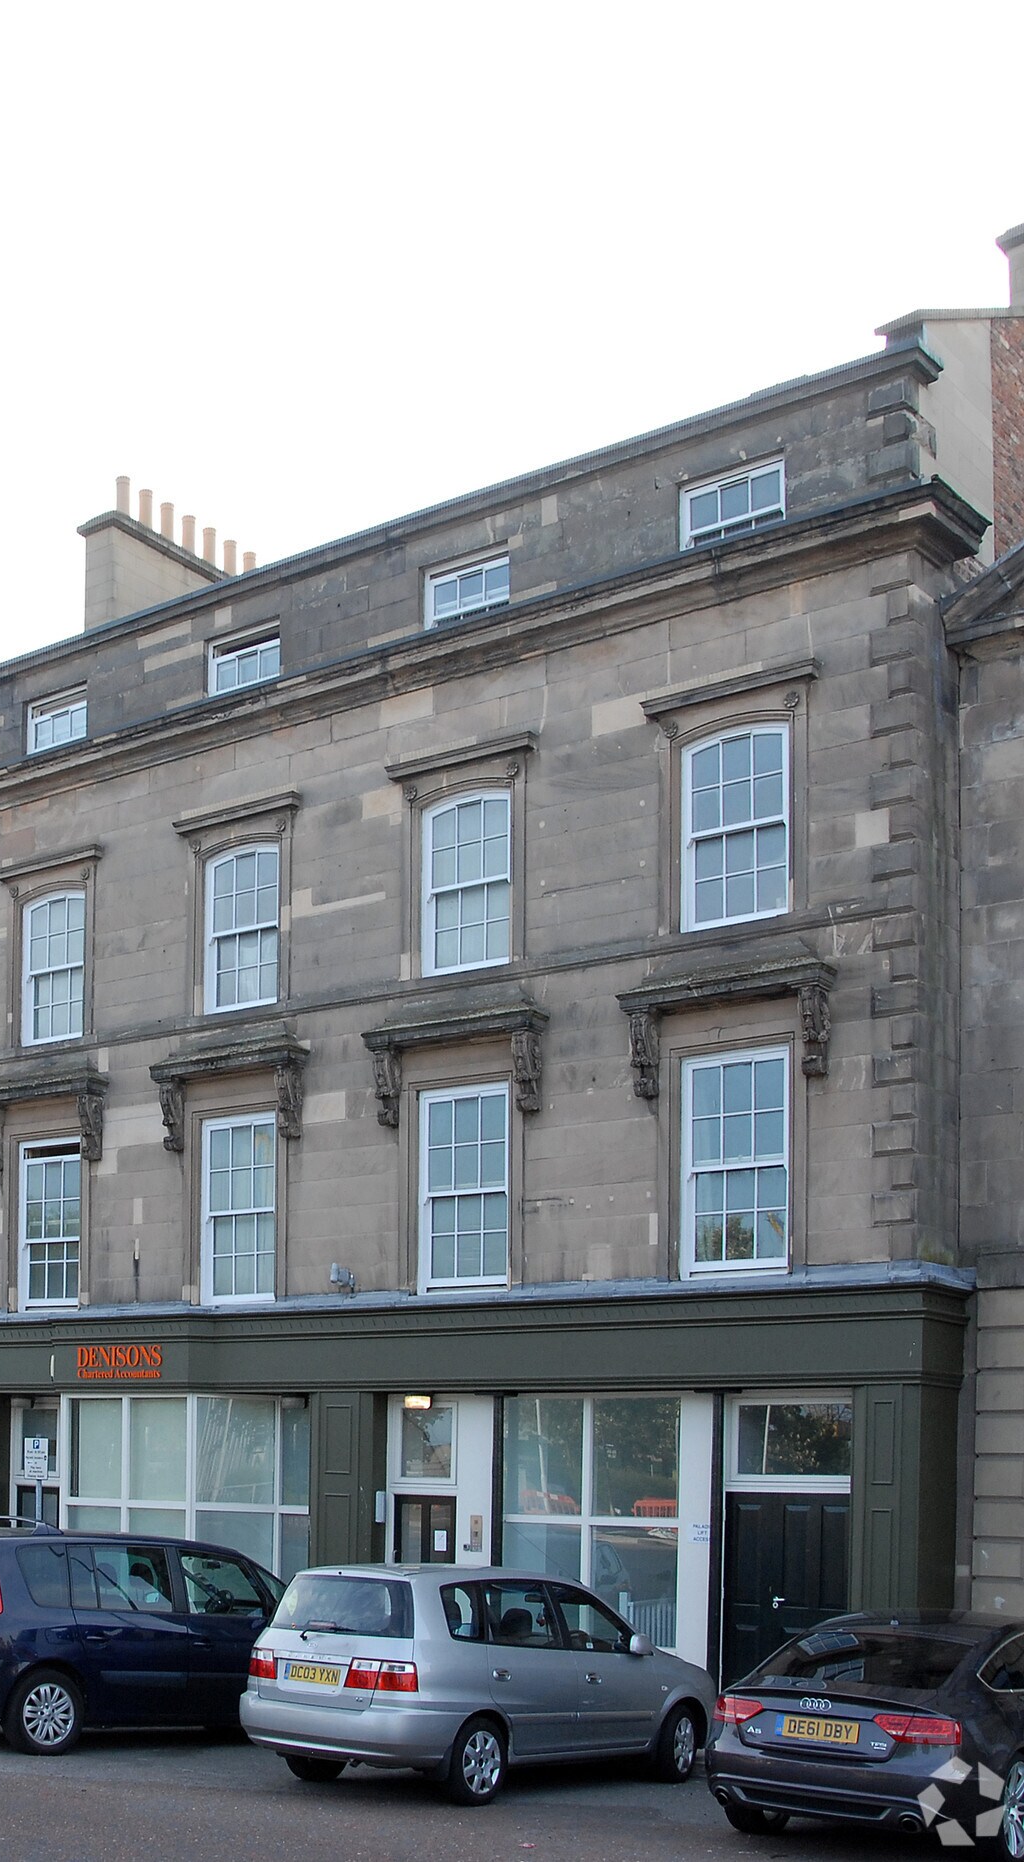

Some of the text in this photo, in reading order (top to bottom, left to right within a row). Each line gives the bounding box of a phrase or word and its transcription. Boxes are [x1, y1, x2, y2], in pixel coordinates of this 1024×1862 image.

[77, 1344, 162, 1368] DENISONS
[77, 1367, 161, 1379] Chartered Accountants
[290, 1665, 338, 1683] DC03 YXN
[747, 1725, 762, 1734] A5
[788, 1719, 853, 1740] DE61 DBY
